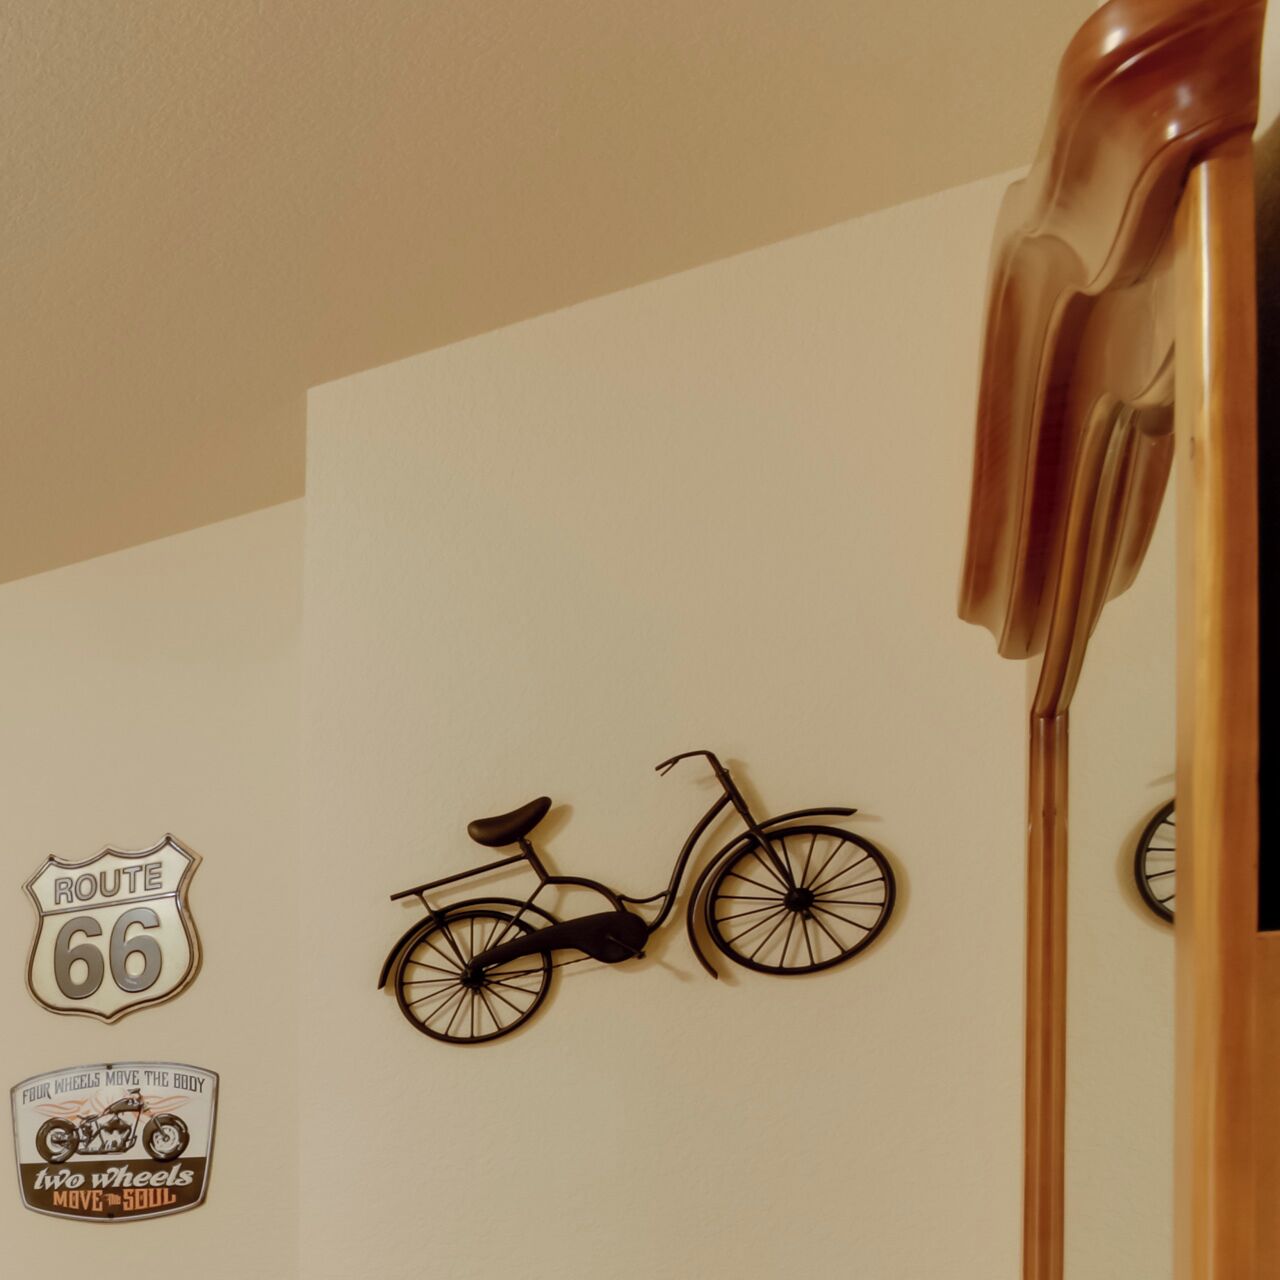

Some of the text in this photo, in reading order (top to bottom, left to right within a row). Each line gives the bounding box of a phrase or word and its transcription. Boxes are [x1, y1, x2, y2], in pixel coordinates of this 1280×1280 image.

[54, 861, 163, 905] ROUTE
[53, 906, 163, 1000] 66
[22, 1070, 206, 1105] FOUR WHEELS MOVE THE BODY
[33, 1163, 195, 1190] two wheels
[53, 1189, 104, 1212] MOVE
[122, 1188, 177, 1212] SOUL
